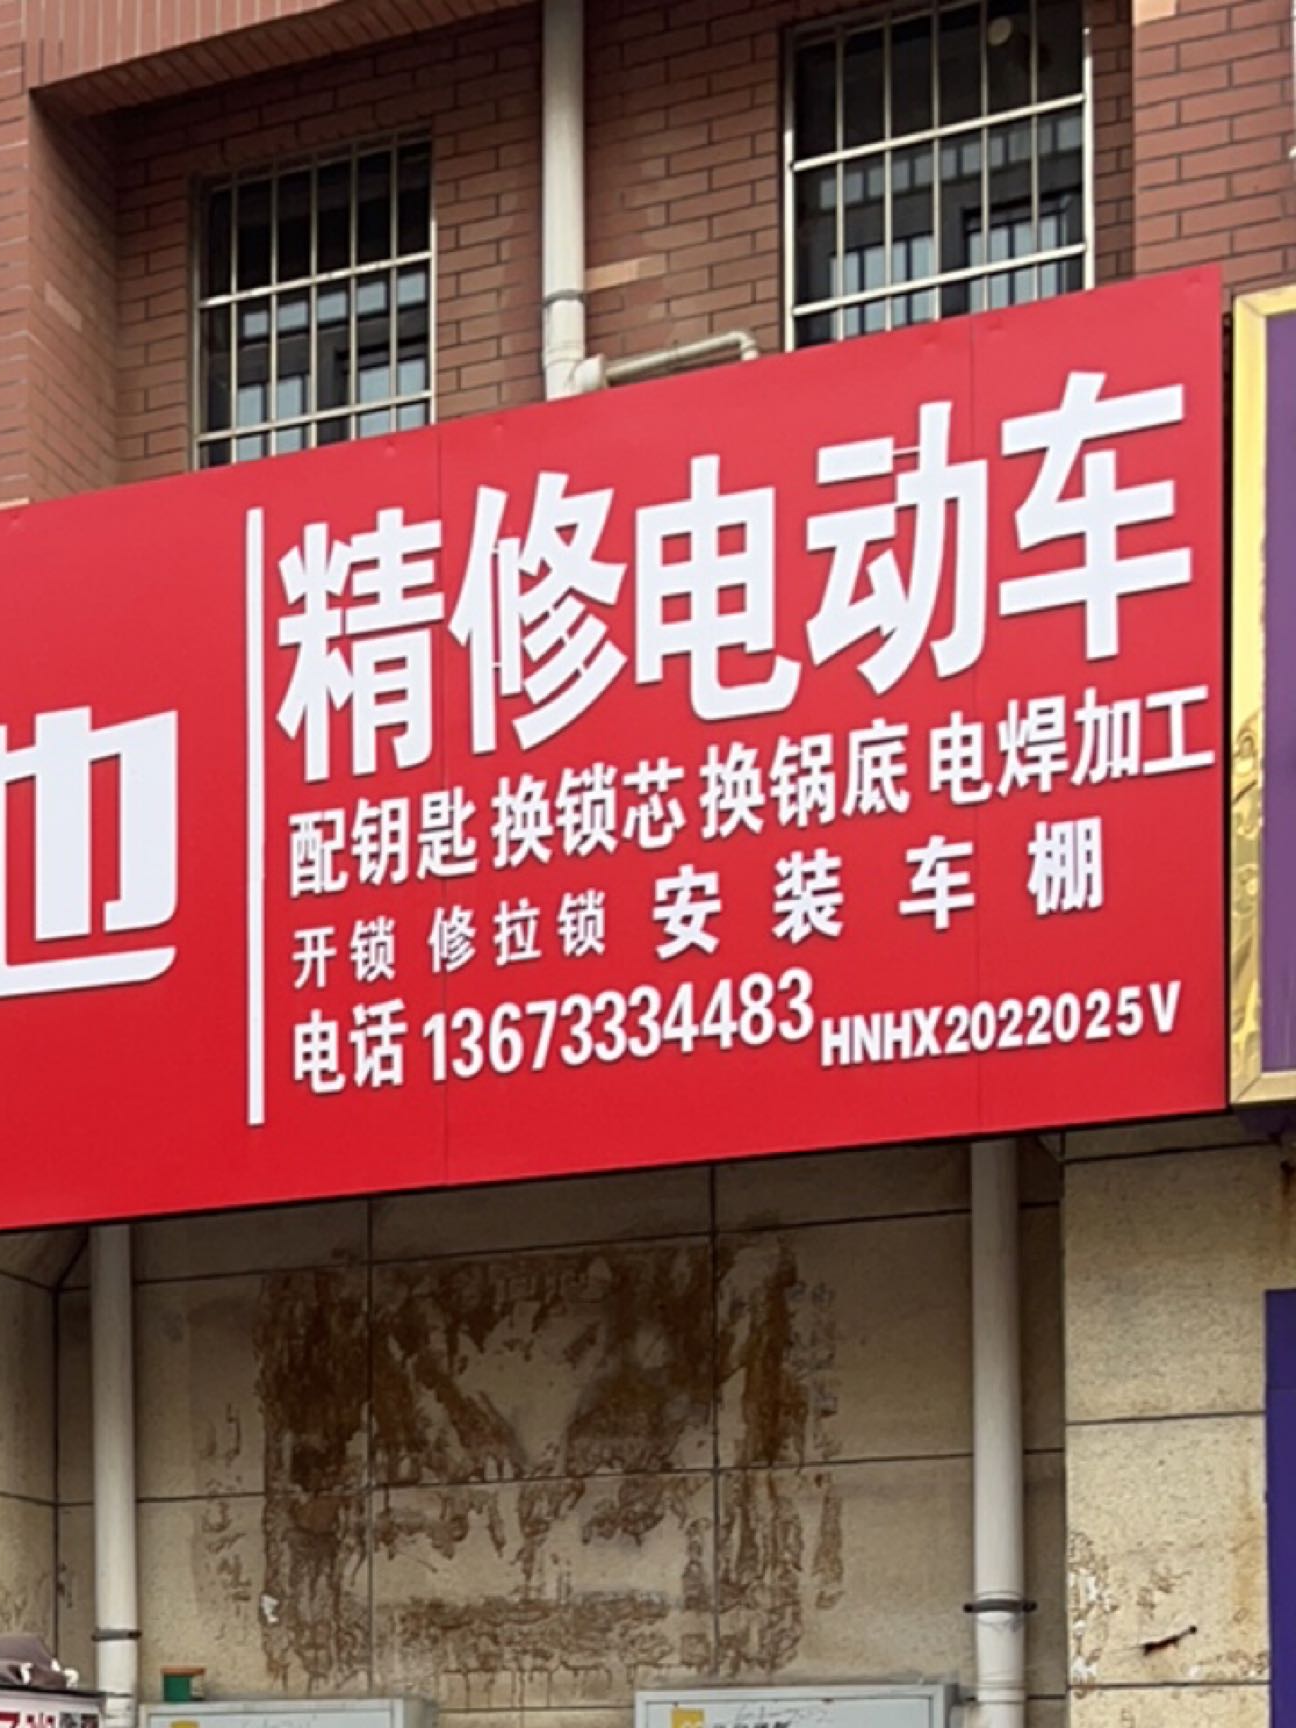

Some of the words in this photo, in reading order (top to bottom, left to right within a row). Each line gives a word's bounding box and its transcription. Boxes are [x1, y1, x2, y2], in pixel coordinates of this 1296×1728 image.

[276, 371, 1193, 781] 精修电动车
[289, 786, 478, 897] 配钥匙
[491, 758, 685, 869] 换锁芯
[700, 718, 910, 840] 换锅底
[928, 685, 1215, 807] 电焊加工
[292, 916, 396, 990] 开锁
[428, 891, 606, 974] 修拉锁
[652, 816, 1104, 961] 安装车棚
[293, 999, 408, 1094] 电话
[422, 967, 814, 1083] 13673334483
[821, 980, 1182, 1068] HNHX2022025V
